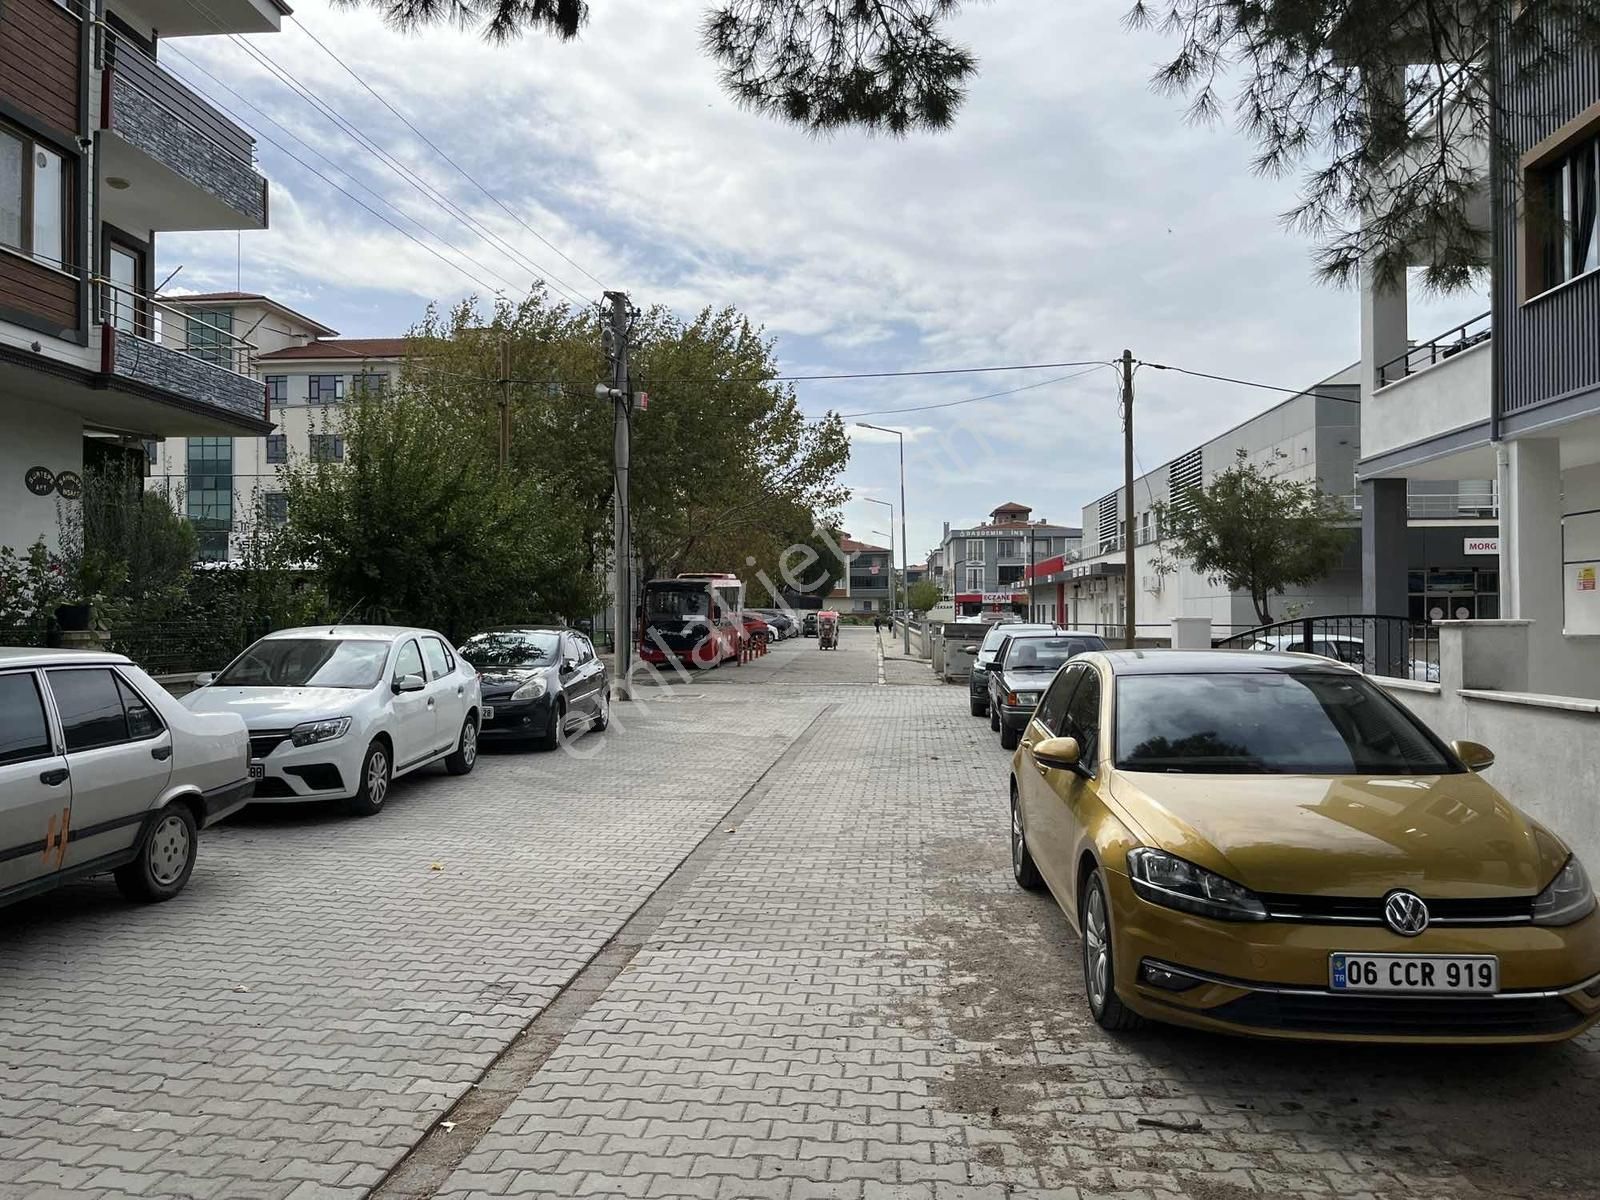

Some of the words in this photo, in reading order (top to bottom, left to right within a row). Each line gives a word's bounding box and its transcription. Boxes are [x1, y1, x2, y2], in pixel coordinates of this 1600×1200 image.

[1334, 974, 1345, 982] TR
[1347, 960, 1378, 985] 06
[1389, 962, 1435, 987] CCR
[1447, 963, 1492, 988] 919
